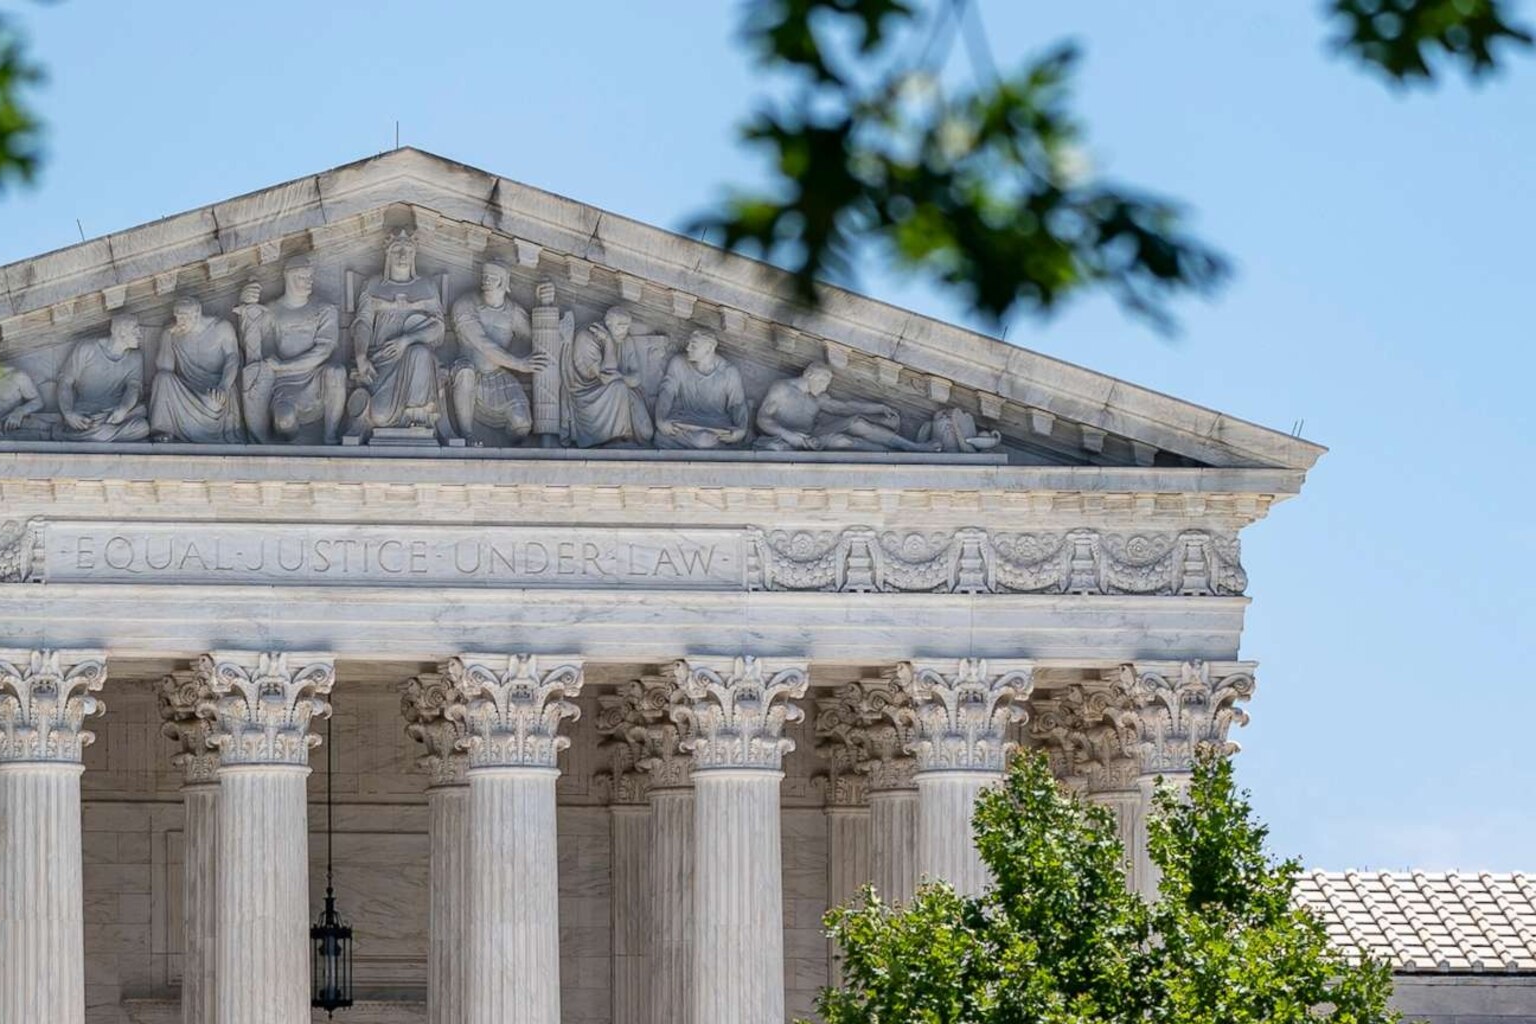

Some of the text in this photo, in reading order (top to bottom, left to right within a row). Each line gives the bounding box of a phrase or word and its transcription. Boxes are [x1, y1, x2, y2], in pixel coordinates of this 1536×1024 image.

[76, 536, 716, 577] EQUAL JUSTICE UNDER LAW
